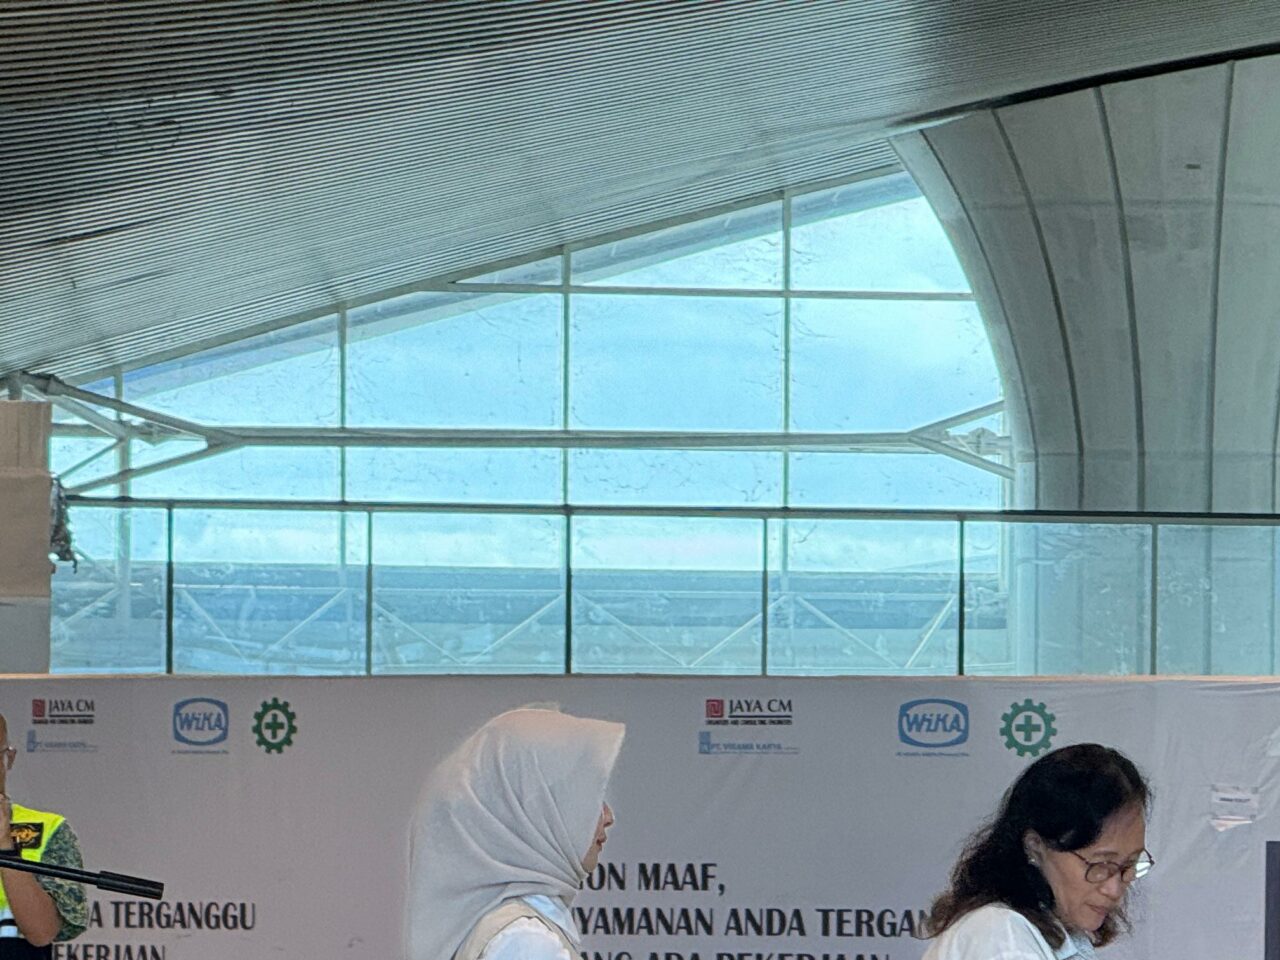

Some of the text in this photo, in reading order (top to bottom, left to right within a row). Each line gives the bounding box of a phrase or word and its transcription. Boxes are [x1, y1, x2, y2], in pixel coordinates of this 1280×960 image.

[49, 699, 95, 713] JAYA CM
[729, 698, 793, 714] JAYA CM
[580, 862, 725, 896] ON MAAF,
[88, 900, 256, 930] A TERGANGGU
[571, 906, 714, 936] YAMANAN
[724, 908, 807, 937] ANDA
